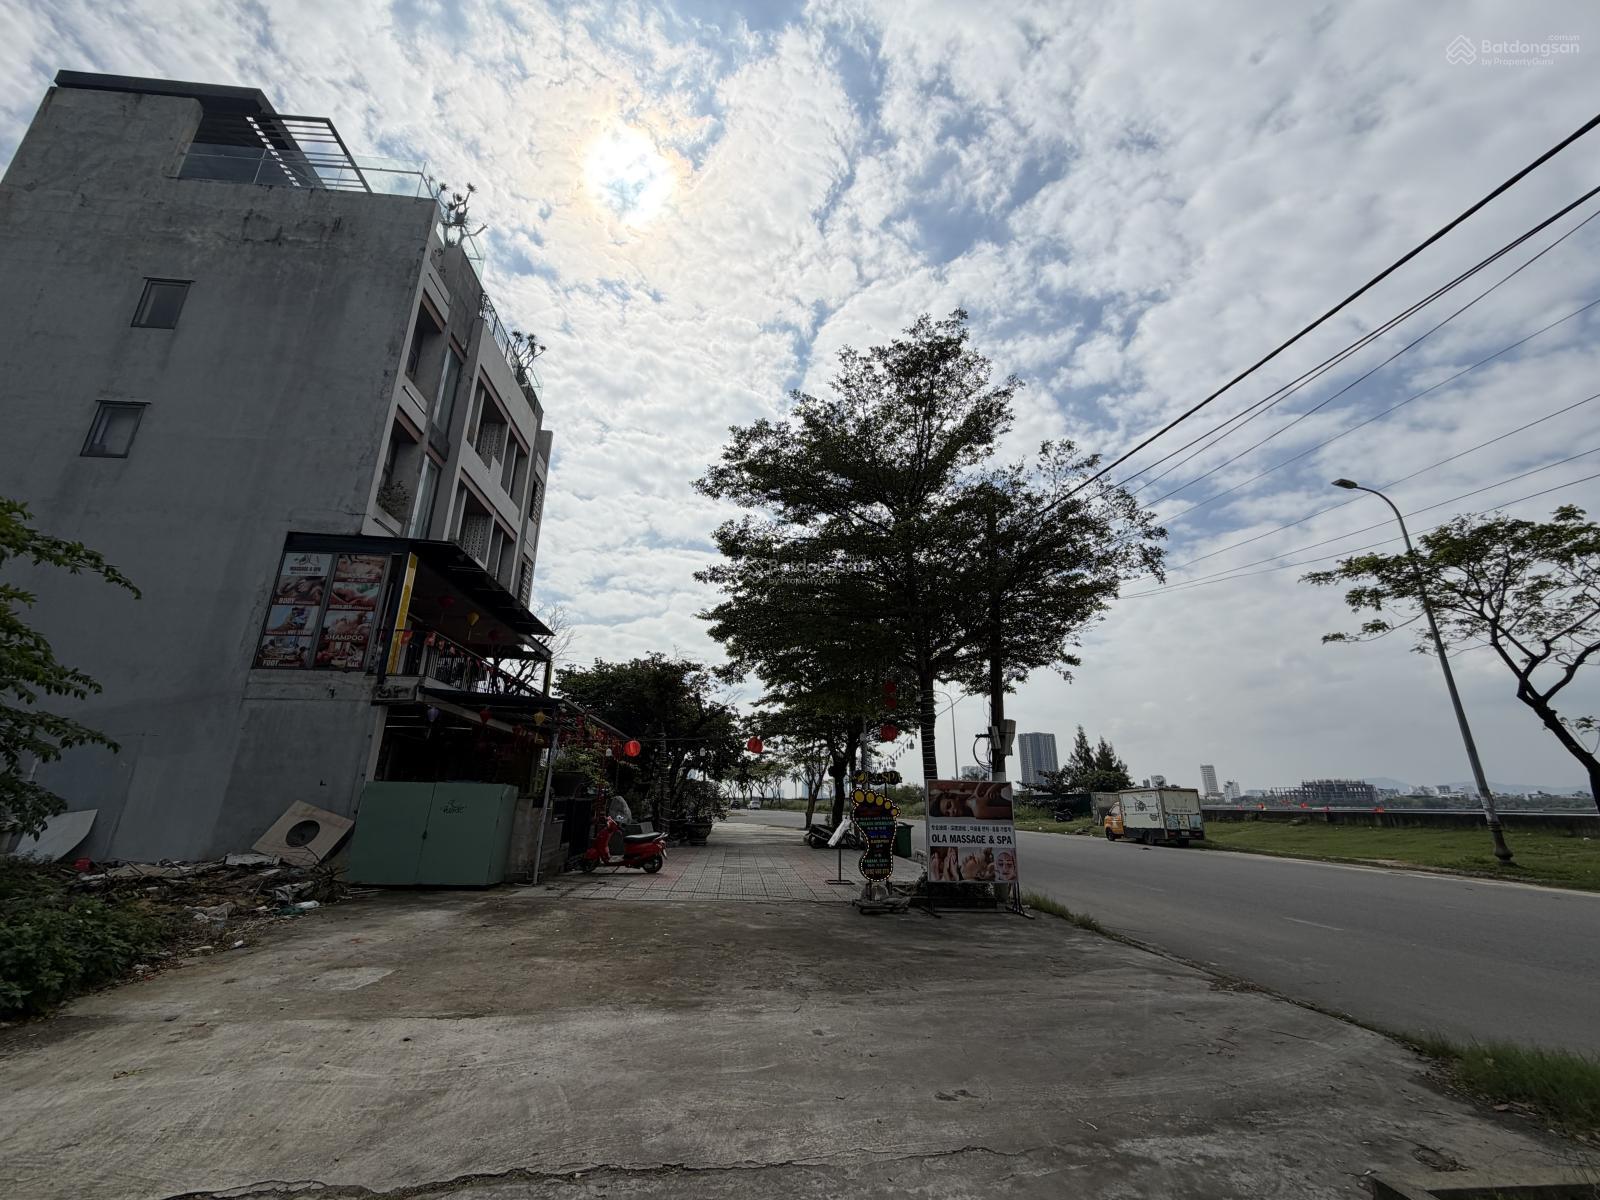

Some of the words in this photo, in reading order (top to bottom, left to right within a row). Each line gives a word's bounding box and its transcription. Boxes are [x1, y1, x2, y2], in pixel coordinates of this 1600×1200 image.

[932, 834, 947, 843] OLA
[950, 835, 985, 844] MASSAGE
[997, 836, 1012, 844] SPA
